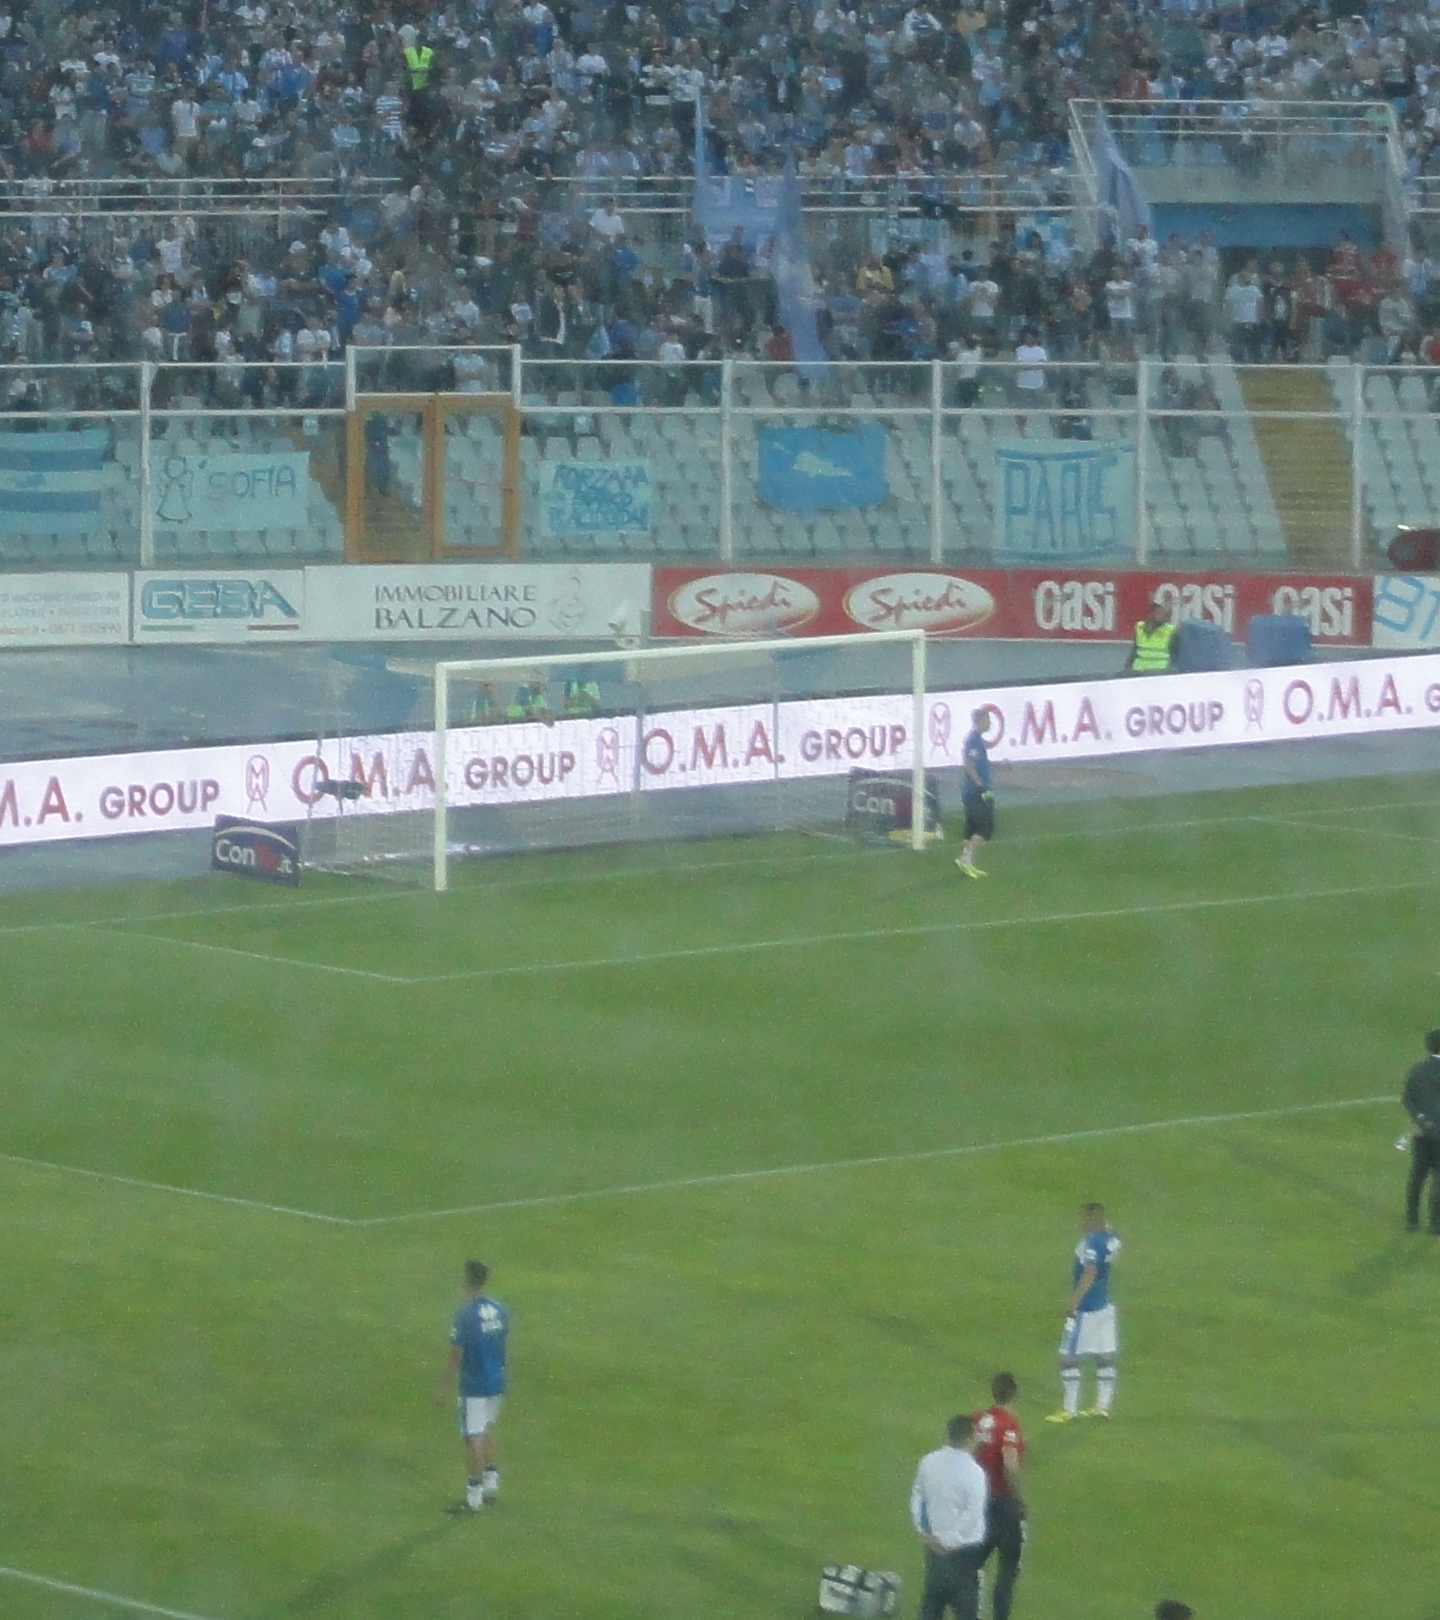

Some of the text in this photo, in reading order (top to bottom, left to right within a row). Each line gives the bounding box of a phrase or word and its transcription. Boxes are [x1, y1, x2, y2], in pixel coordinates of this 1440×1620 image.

[208, 464, 297, 499] SOFIA
[374, 583, 537, 603] IMMOBILIARE
[374, 607, 537, 631] BALZANO
[1124, 699, 1224, 738] GROUP
[1282, 672, 1413, 726] O.M.A.
[800, 724, 908, 764] GROUP
[464, 750, 575, 792] GROUP
[99, 779, 221, 821] GROUP
